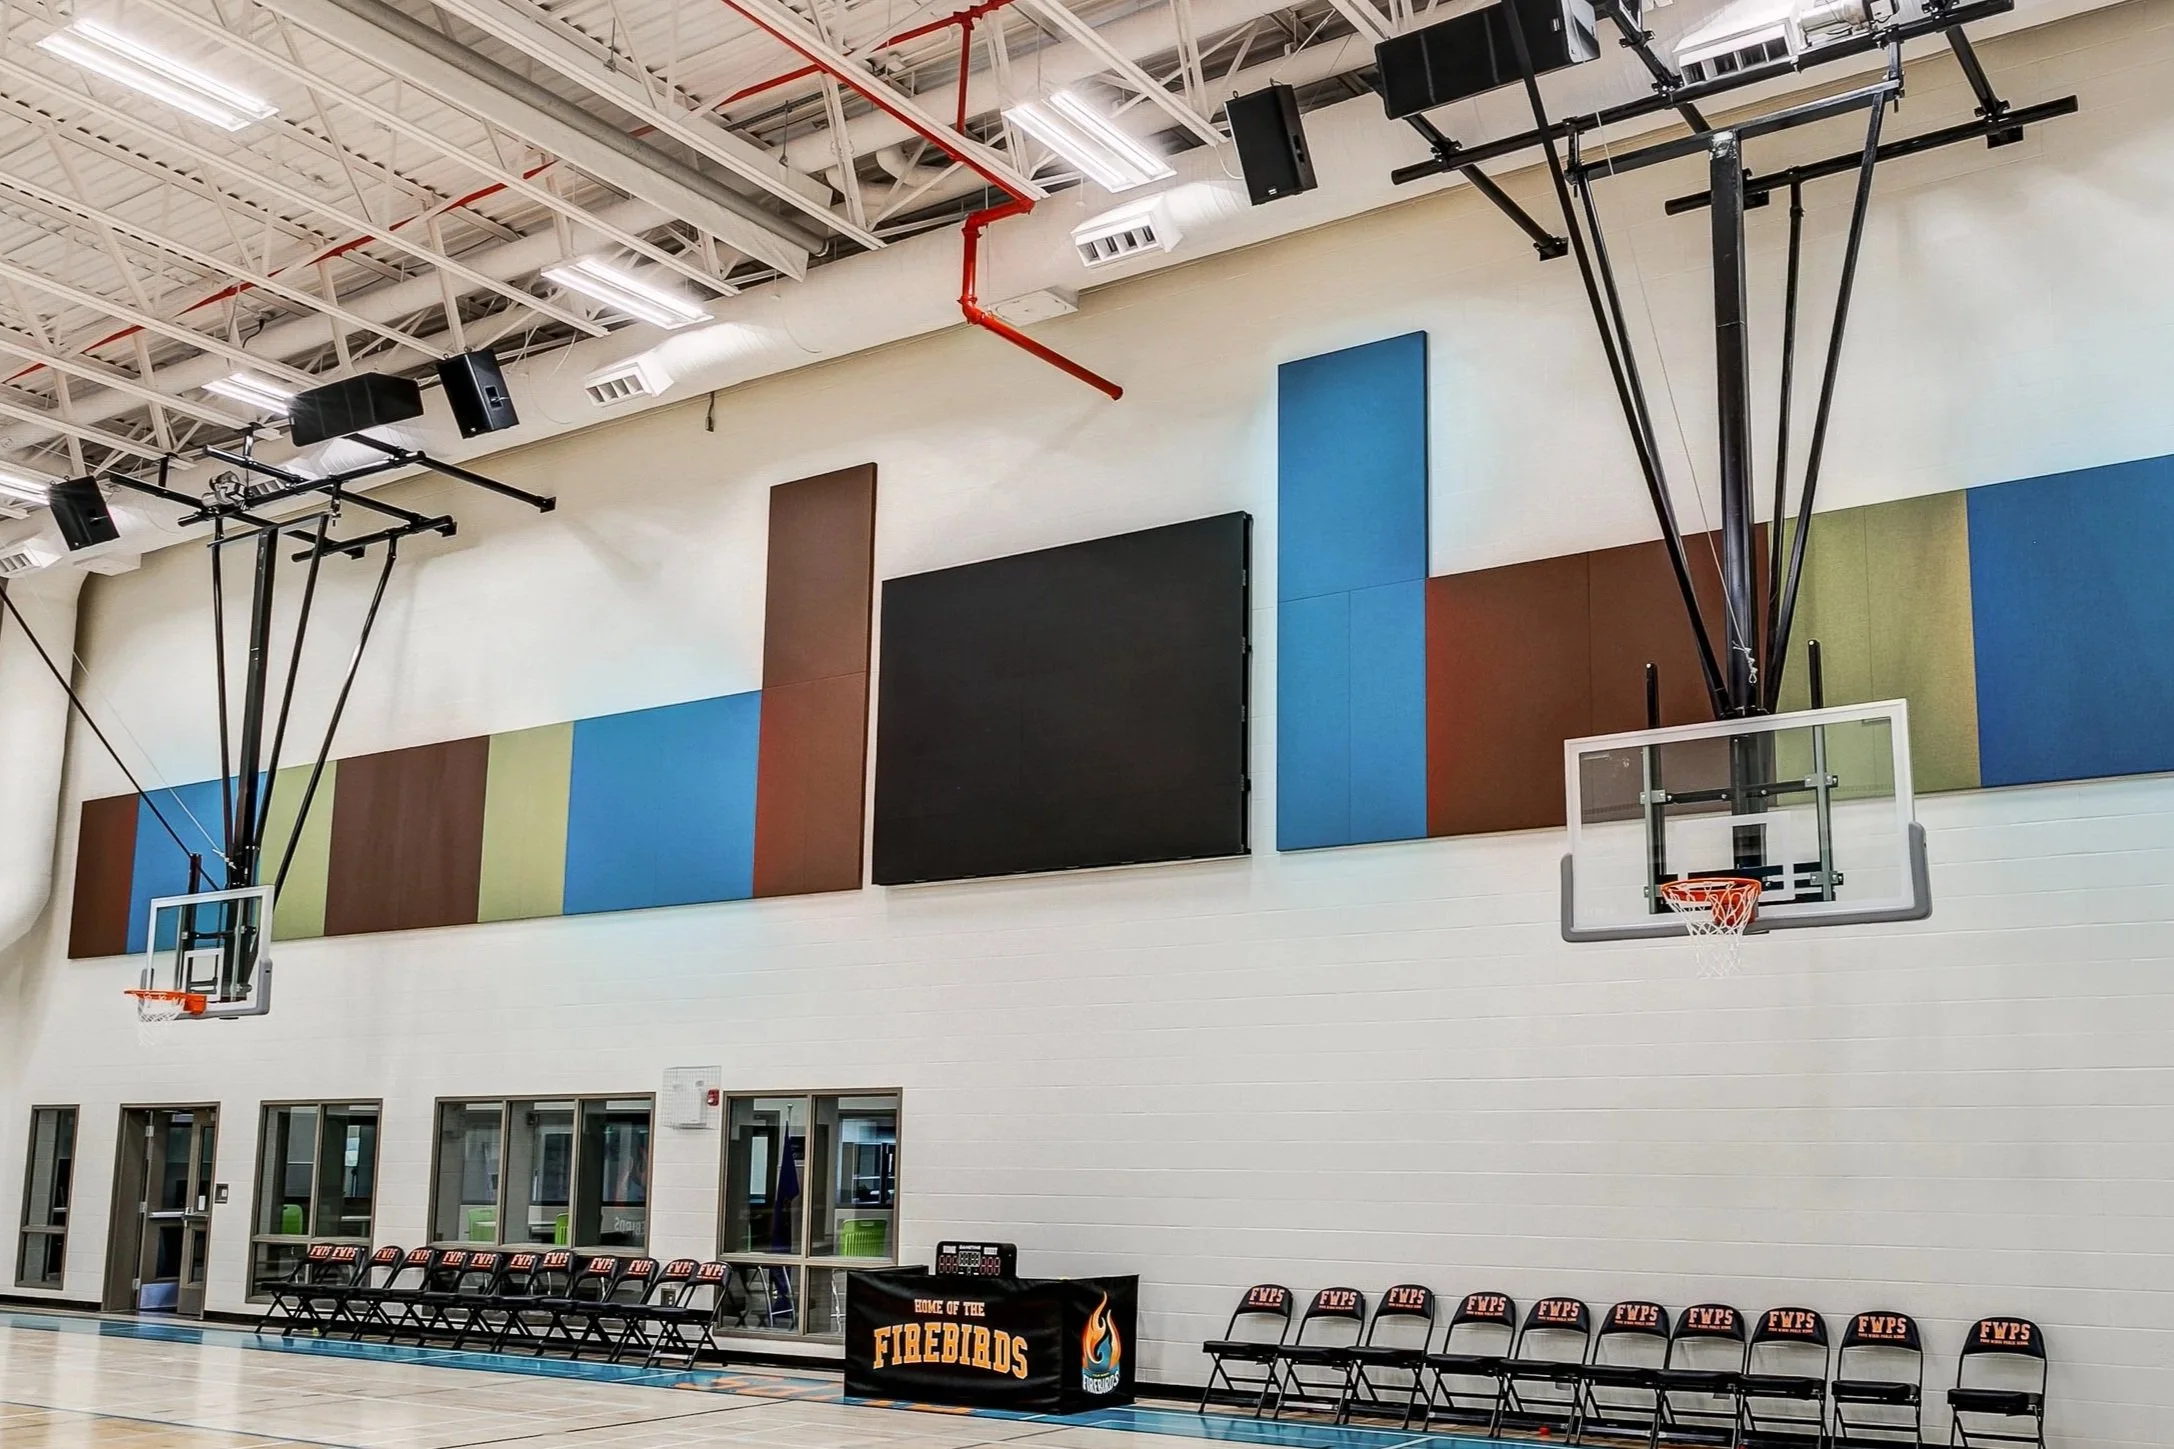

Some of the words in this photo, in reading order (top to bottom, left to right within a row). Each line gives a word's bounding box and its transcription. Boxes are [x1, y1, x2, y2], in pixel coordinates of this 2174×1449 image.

[331, 1246, 359, 1258] FWPS
[409, 1249, 433, 1260] FWPS
[471, 1253, 497, 1264] FWPS
[510, 1254, 536, 1266] FWPS
[543, 1252, 570, 1264] FWPS
[590, 1257, 616, 1269] FWPS
[628, 1259, 654, 1272] FWPS
[666, 1261, 695, 1273] FWPS
[697, 1263, 727, 1276] FWPS
[1249, 1287, 1285, 1302] FWPS
[1319, 1290, 1357, 1306] FWPS
[1388, 1287, 1426, 1304] FWPS
[914, 1298, 943, 1314] HOME
[946, 1300, 960, 1315] OF
[963, 1301, 985, 1317] THE
[1466, 1295, 1507, 1312] FWPS
[1538, 1300, 1580, 1317] FWPS
[1614, 1303, 1659, 1321] FWPS
[1688, 1307, 1734, 1325] FWPS
[1768, 1310, 1816, 1328] FWPS
[1857, 1315, 1907, 1334] FWPS
[1980, 1320, 2031, 1340] FWPS
[873, 1322, 1028, 1380] FIREBIRDS
[1082, 1370, 1120, 1394] FIREBIRDS
